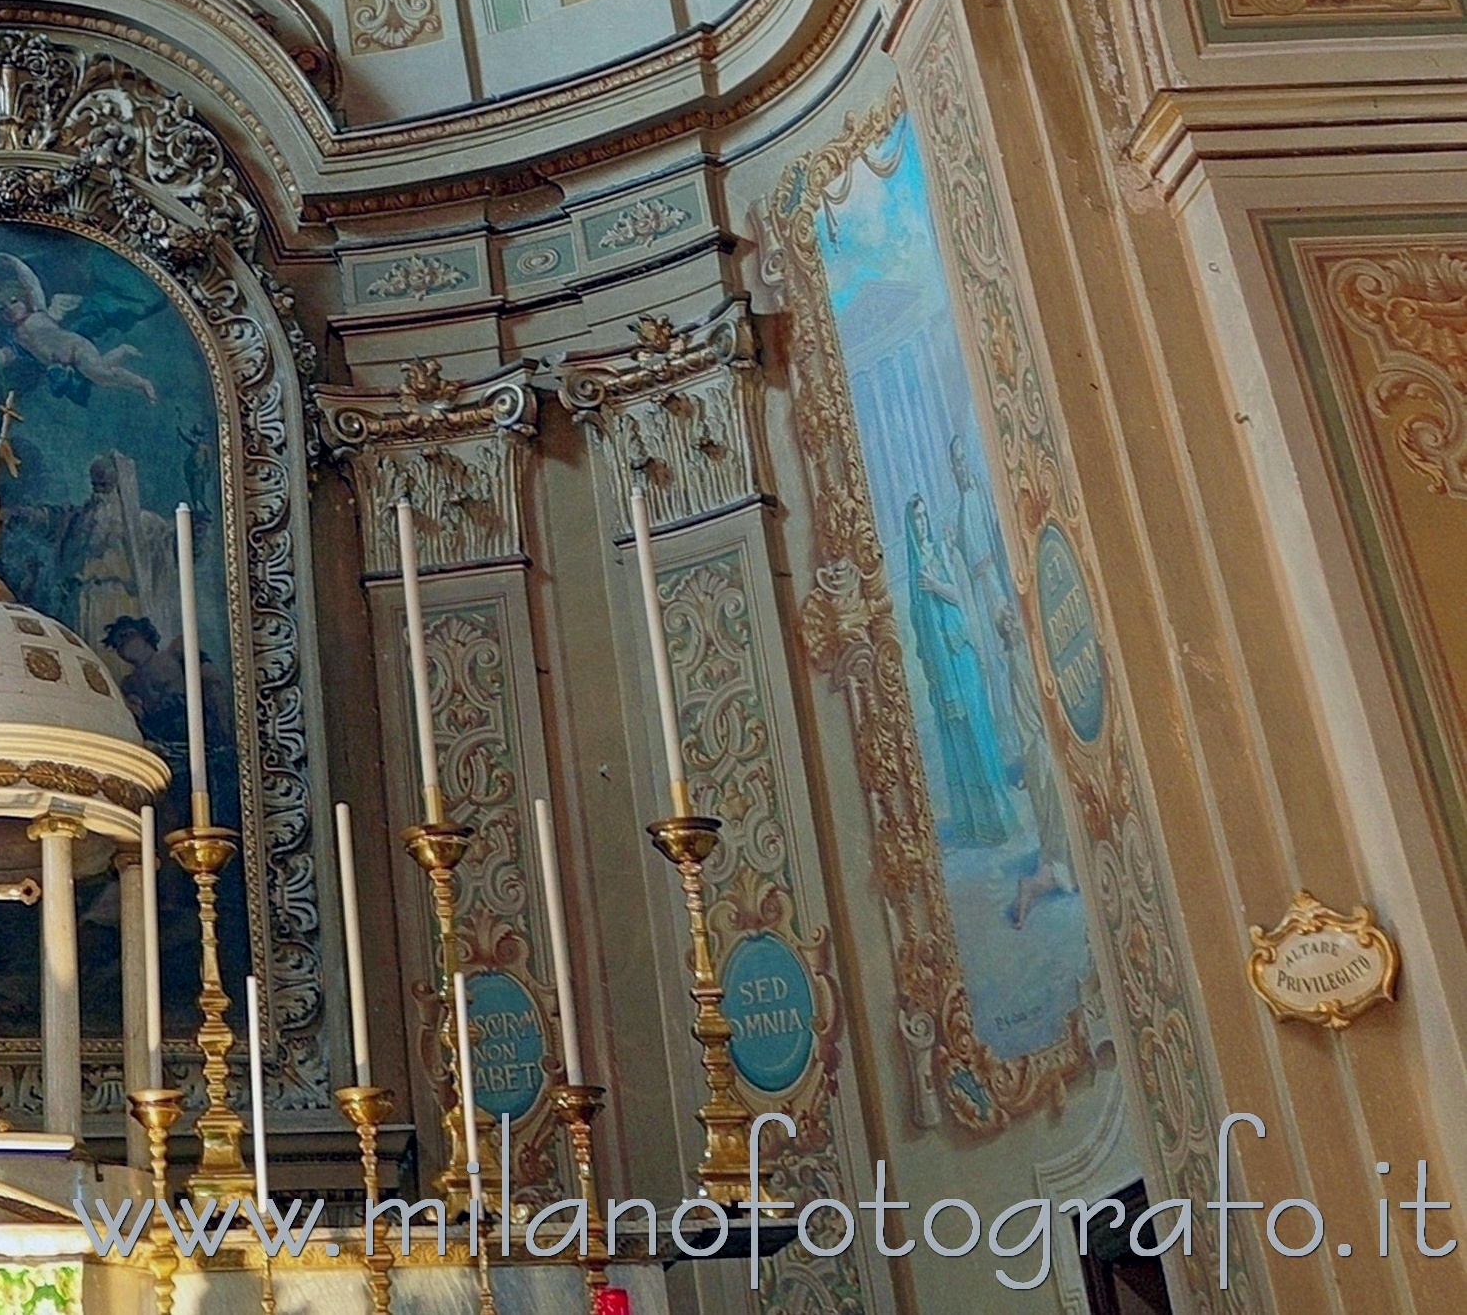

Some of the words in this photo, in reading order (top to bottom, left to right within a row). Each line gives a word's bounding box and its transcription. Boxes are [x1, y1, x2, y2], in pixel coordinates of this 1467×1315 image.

[1285, 941, 1341, 968] ALTARE
[1276, 955, 1371, 994] PRIVILEGIATO
[739, 975, 789, 1006] SED
[472, 1041, 518, 1063] NON
[472, 1062, 536, 1093] ABET
